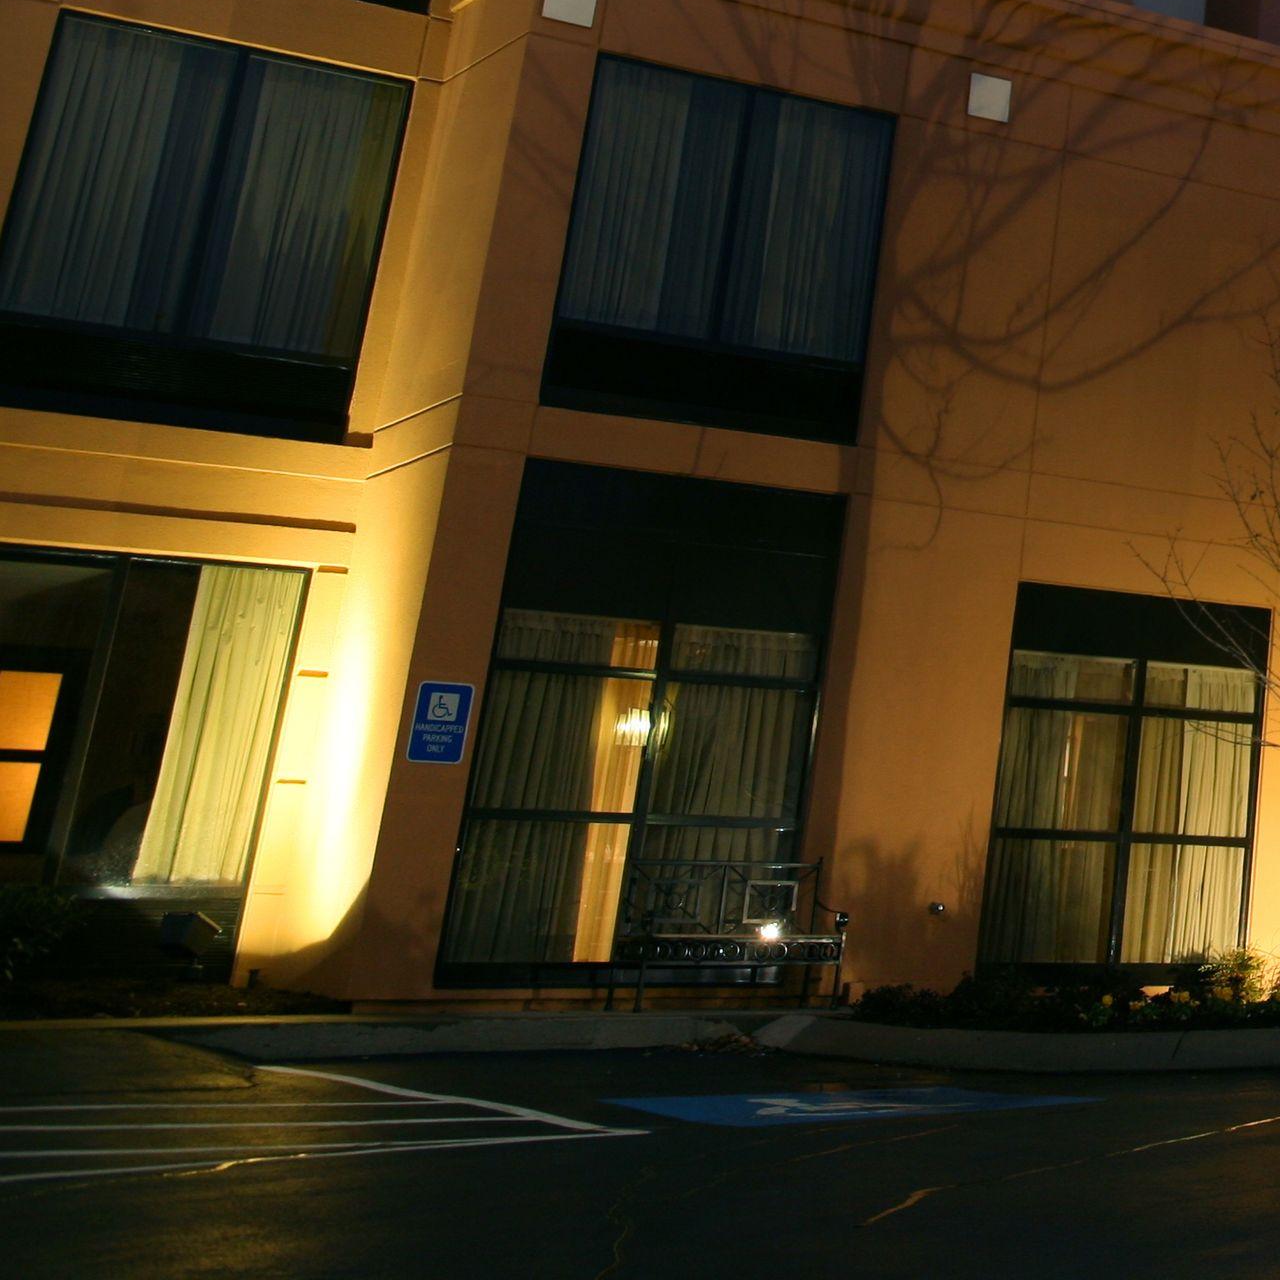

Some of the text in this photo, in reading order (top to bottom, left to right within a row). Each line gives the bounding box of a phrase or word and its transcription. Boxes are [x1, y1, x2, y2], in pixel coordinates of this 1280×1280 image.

[415, 723, 464, 733] HANDICAPPED
[423, 734, 453, 743] PARKING
[427, 744, 445, 753] ONLY
